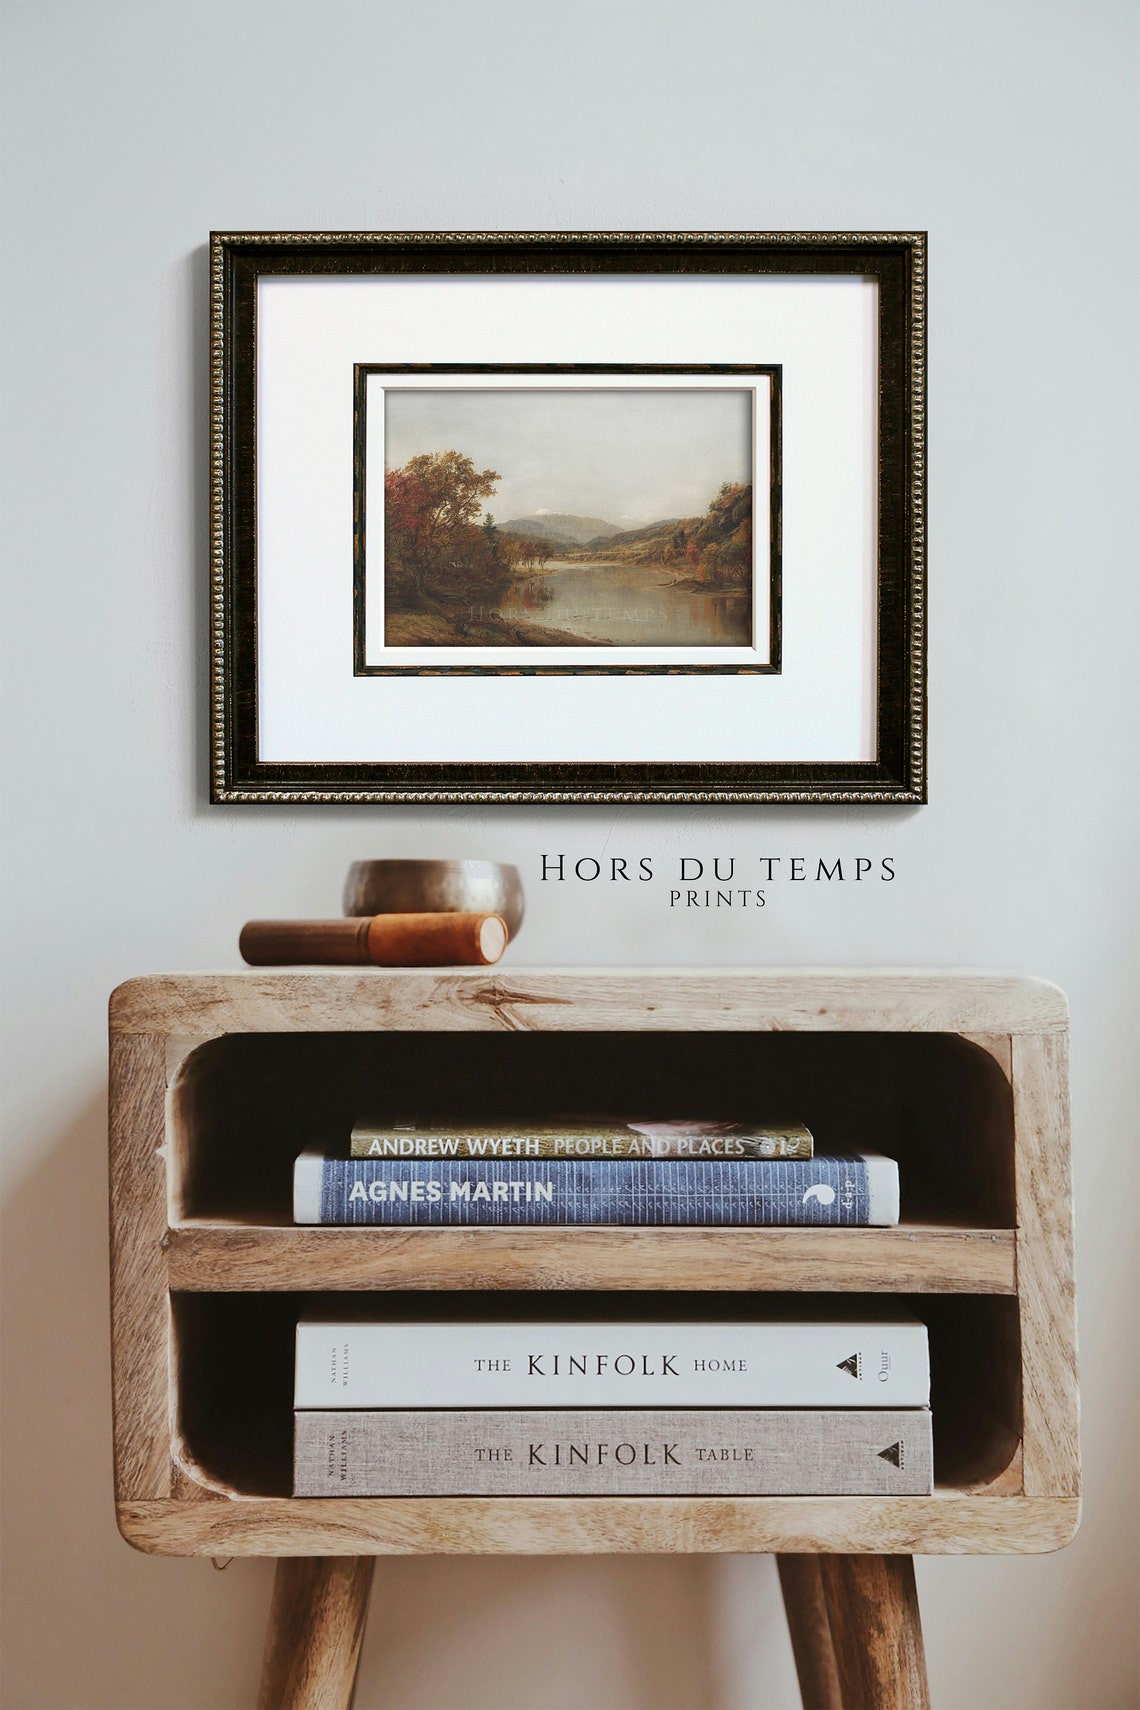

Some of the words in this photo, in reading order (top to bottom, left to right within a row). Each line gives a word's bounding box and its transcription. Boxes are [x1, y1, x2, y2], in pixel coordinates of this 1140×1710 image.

[368, 1137, 459, 1156] ANDREW
[466, 1137, 540, 1156] WYETH
[553, 1137, 622, 1155] PEOPLE
[628, 1137, 670, 1155] AND
[677, 1137, 746, 1155] PLACES
[348, 1180, 442, 1203] AGNES
[450, 1180, 553, 1203] MARTIN
[474, 1359, 512, 1372] THE
[527, 1354, 680, 1376] KINFOLK
[693, 1359, 748, 1372] HOME
[328, 1434, 336, 1477] NATHAN
[340, 1430, 348, 1481] WILLIAMS
[474, 1448, 513, 1461] THE
[528, 1443, 682, 1465] KINFOLK
[695, 1448, 754, 1461] TABLE
